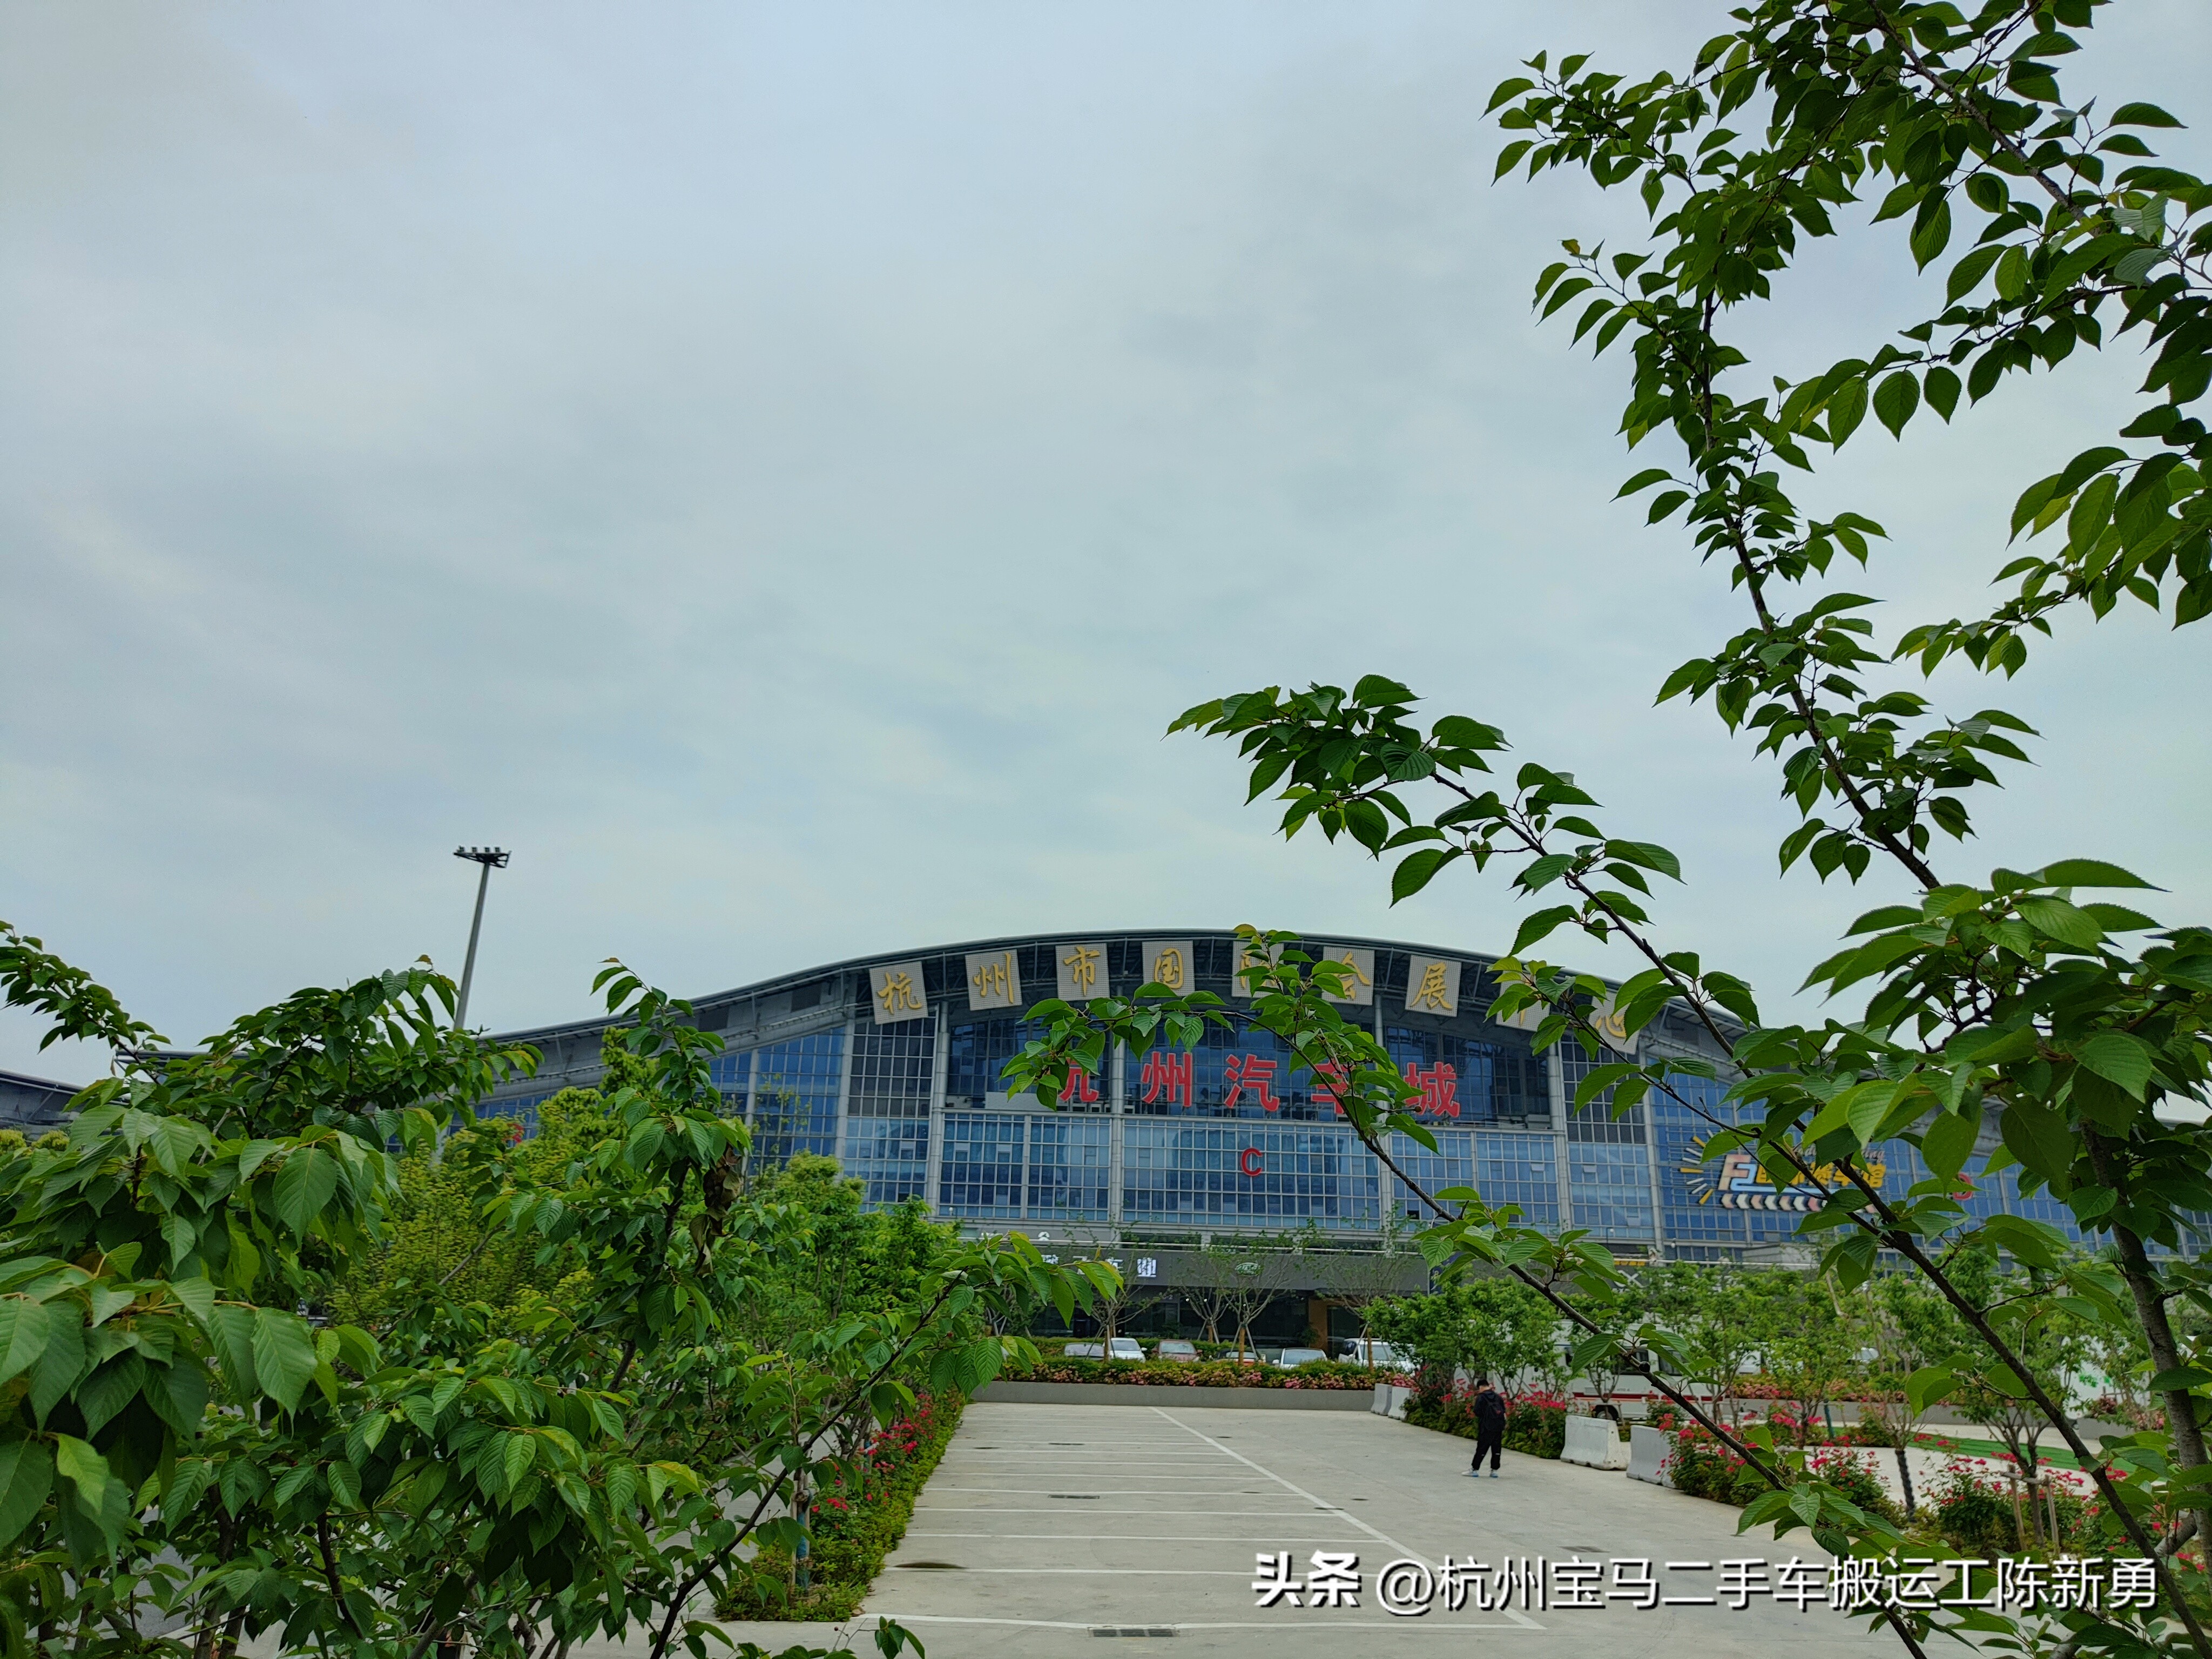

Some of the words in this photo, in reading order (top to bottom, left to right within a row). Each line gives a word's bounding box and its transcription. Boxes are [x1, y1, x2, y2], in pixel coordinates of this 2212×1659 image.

[876, 946, 1628, 1039] 杭州市国会展心
[1240, 1147, 1263, 1177] C
